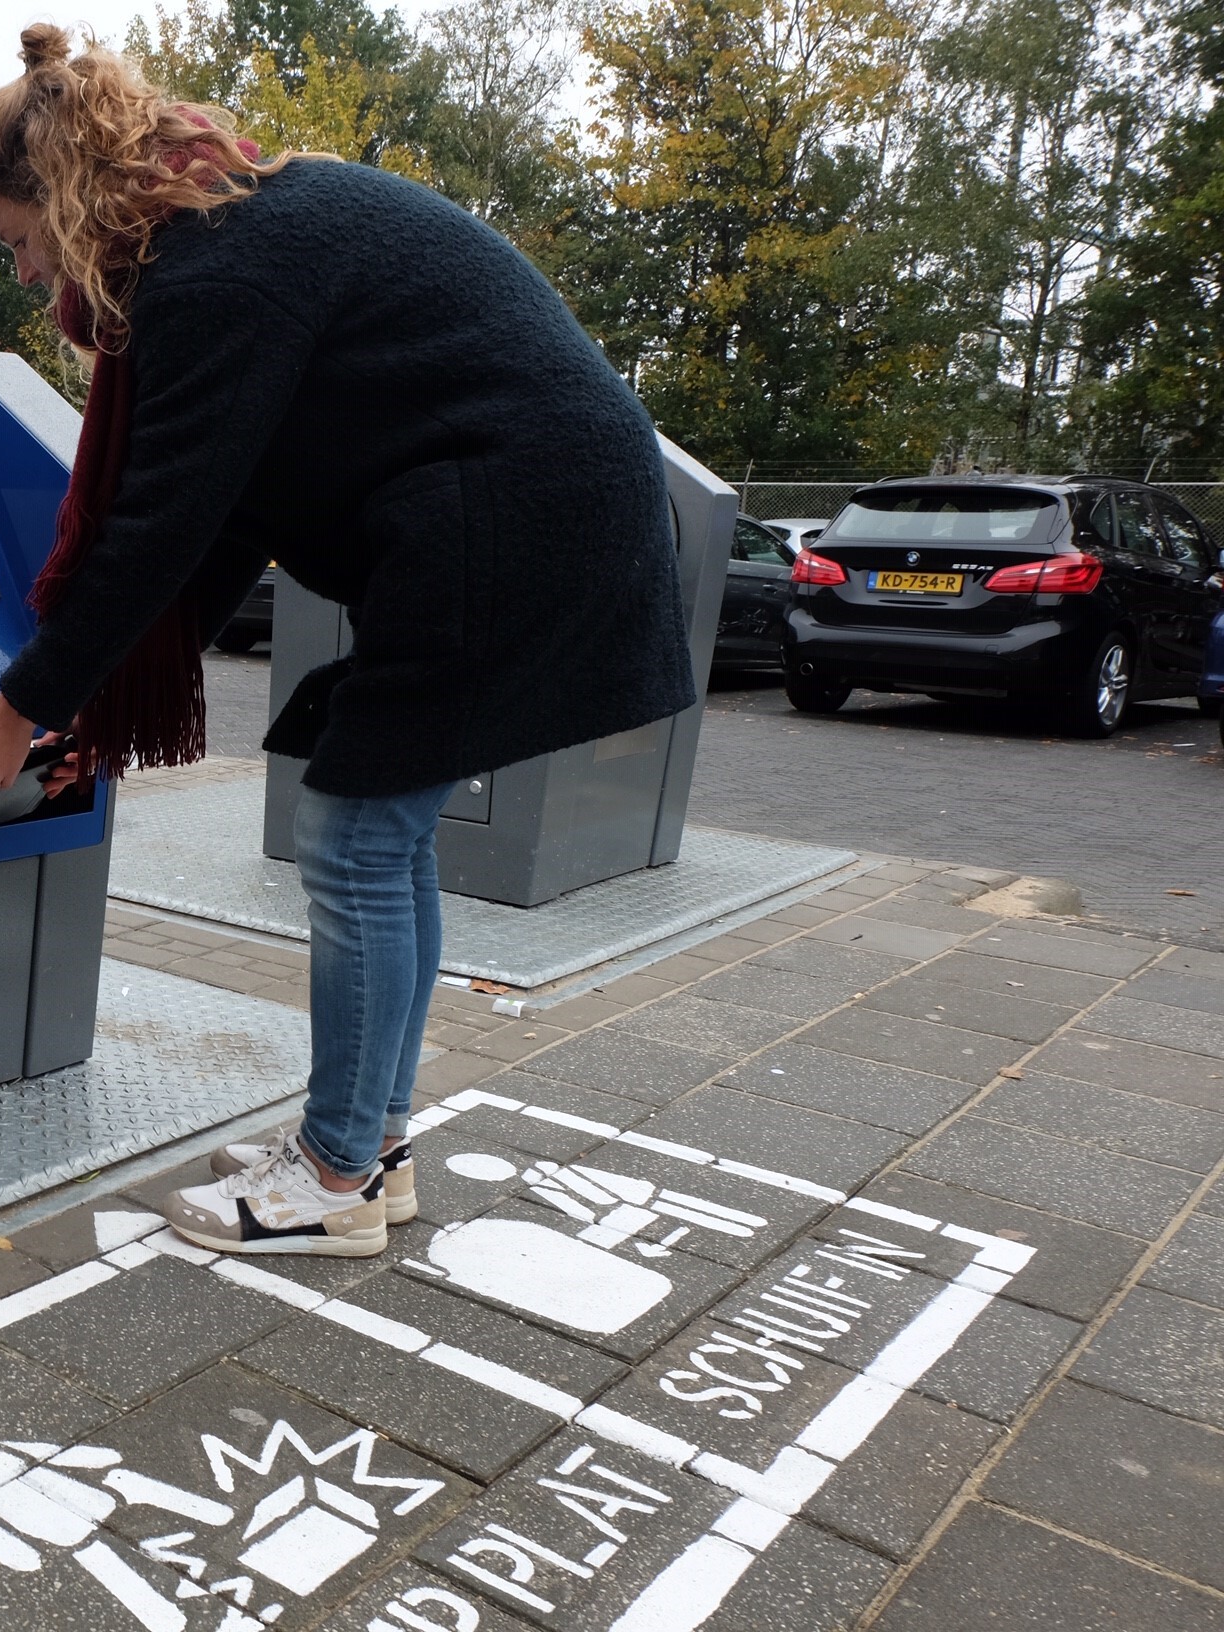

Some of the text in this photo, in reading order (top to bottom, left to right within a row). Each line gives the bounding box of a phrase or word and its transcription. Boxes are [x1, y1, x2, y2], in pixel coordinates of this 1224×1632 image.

[880, 573, 956, 590] KD-754-R
[659, 1228, 926, 1420] SCHUIF IN
[446, 1442, 674, 1614] PLAT
